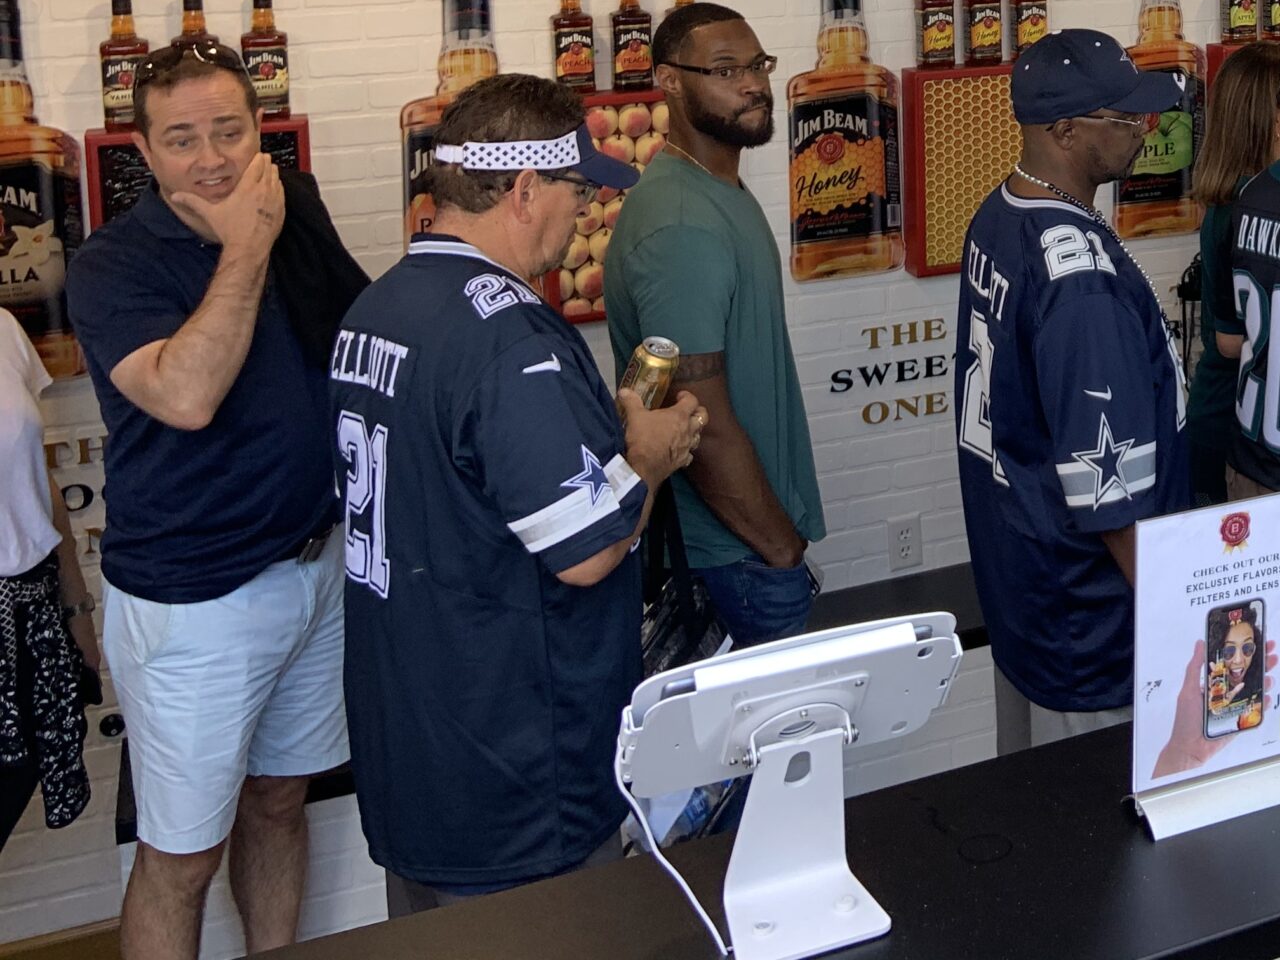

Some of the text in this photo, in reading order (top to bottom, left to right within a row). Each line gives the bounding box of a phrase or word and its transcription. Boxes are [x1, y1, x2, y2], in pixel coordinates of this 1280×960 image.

[795, 109, 868, 148] JIM BEAM
[1144, 141, 1176, 159] PLE
[0, 184, 38, 212] AM
[796, 165, 865, 202] Honey
[1040, 224, 1118, 281] 21
[464, 273, 543, 320] 21
[861, 318, 948, 349] THE
[330, 329, 409, 398] ELLIOTT
[829, 353, 957, 393] SWEE
[862, 391, 949, 425] ONE
[337, 409, 390, 599] 21
[1193, 552, 1280, 578] CHECK OUT OUR
[1186, 574, 1239, 594] EXCLUSIVE
[1190, 579, 1279, 606] FILTERS AND LENS
